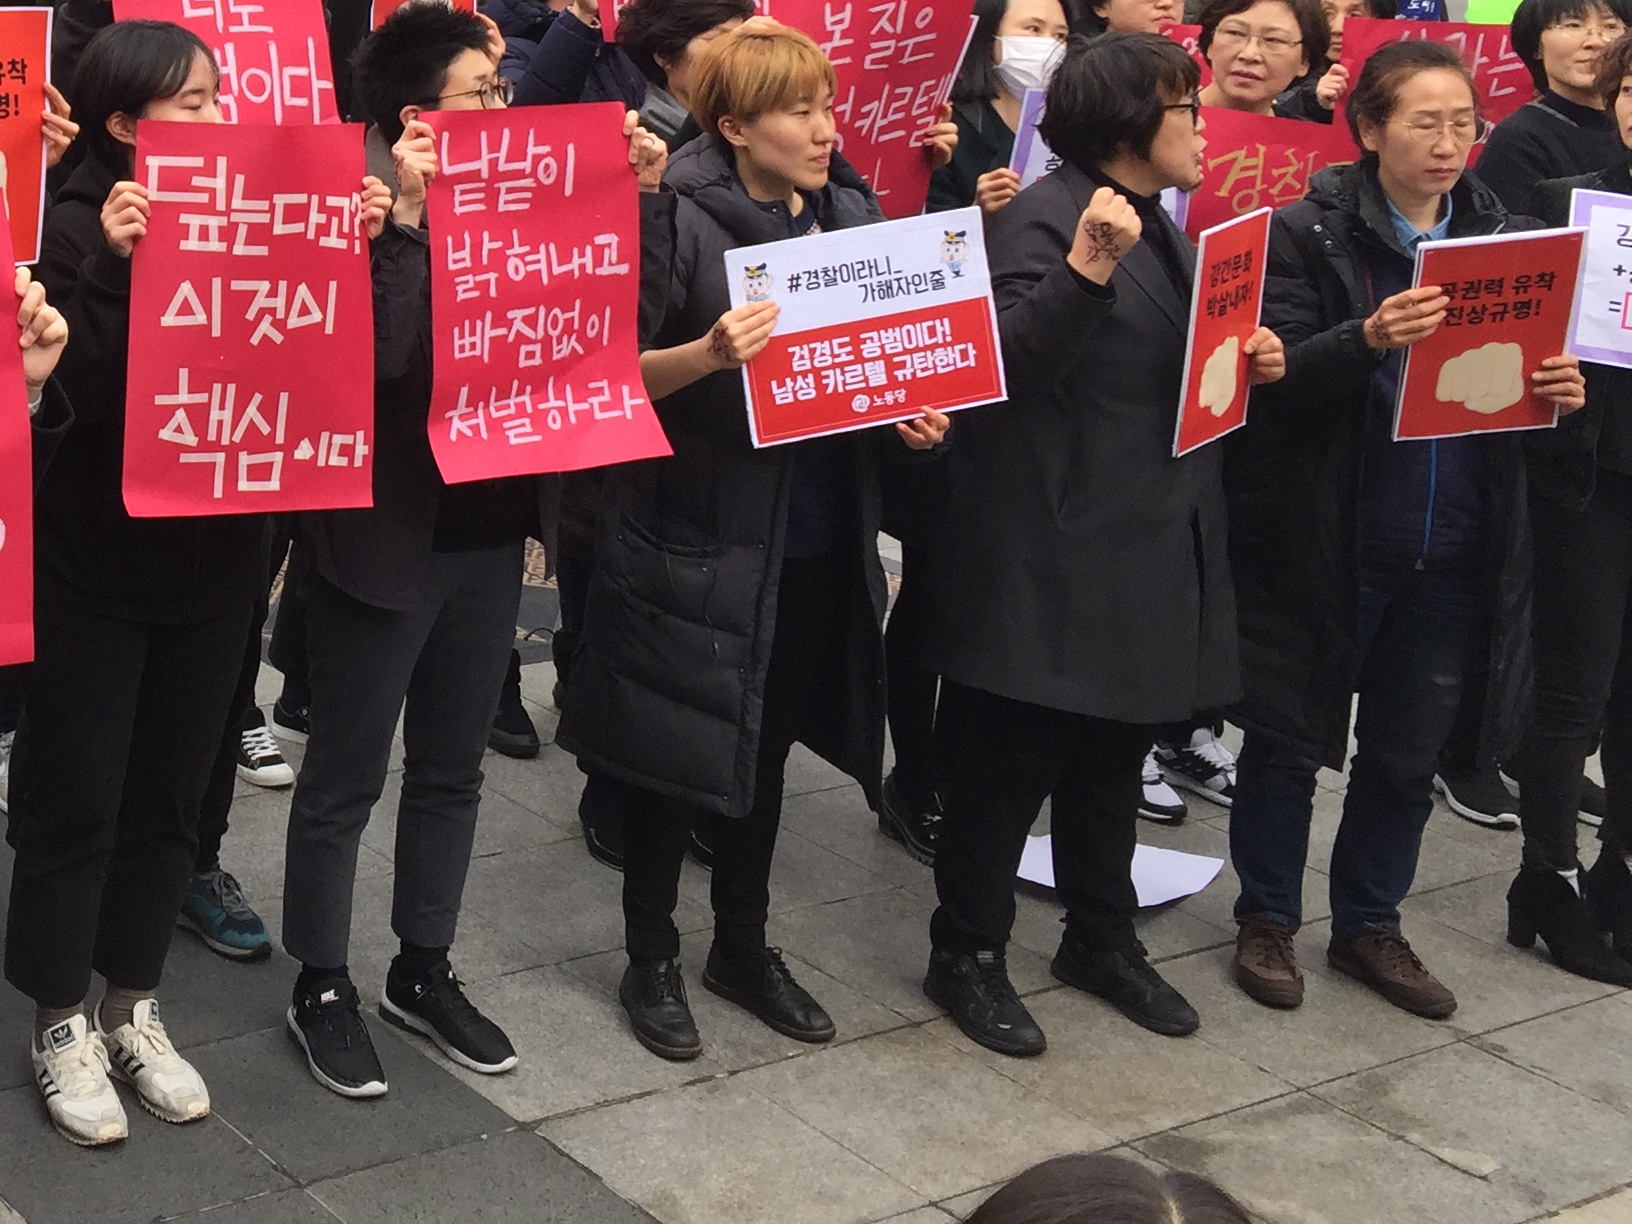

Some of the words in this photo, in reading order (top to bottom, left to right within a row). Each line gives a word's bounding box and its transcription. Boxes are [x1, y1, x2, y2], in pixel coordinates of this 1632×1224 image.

[439, 129, 575, 216] 낱낱이
[145, 154, 363, 257] 덮는다고?
[447, 229, 630, 303] 밝혀내고
[858, 270, 947, 304] 가해자인줄
[1440, 277, 1505, 301] 공권력
[1511, 271, 1557, 295] 유착
[159, 276, 338, 346] 이것이
[452, 298, 611, 368] 빠짐없이
[1444, 299, 1542, 327] 진상규명!
[770, 378, 817, 405] 남성
[822, 360, 888, 395] 카르텔
[893, 342, 978, 382] 규탄한다
[786, 336, 855, 372] 검경도
[859, 317, 953, 353] 공범이다!
[444, 378, 647, 445] 처벌하라
[872, 388, 907, 407] 노동당
